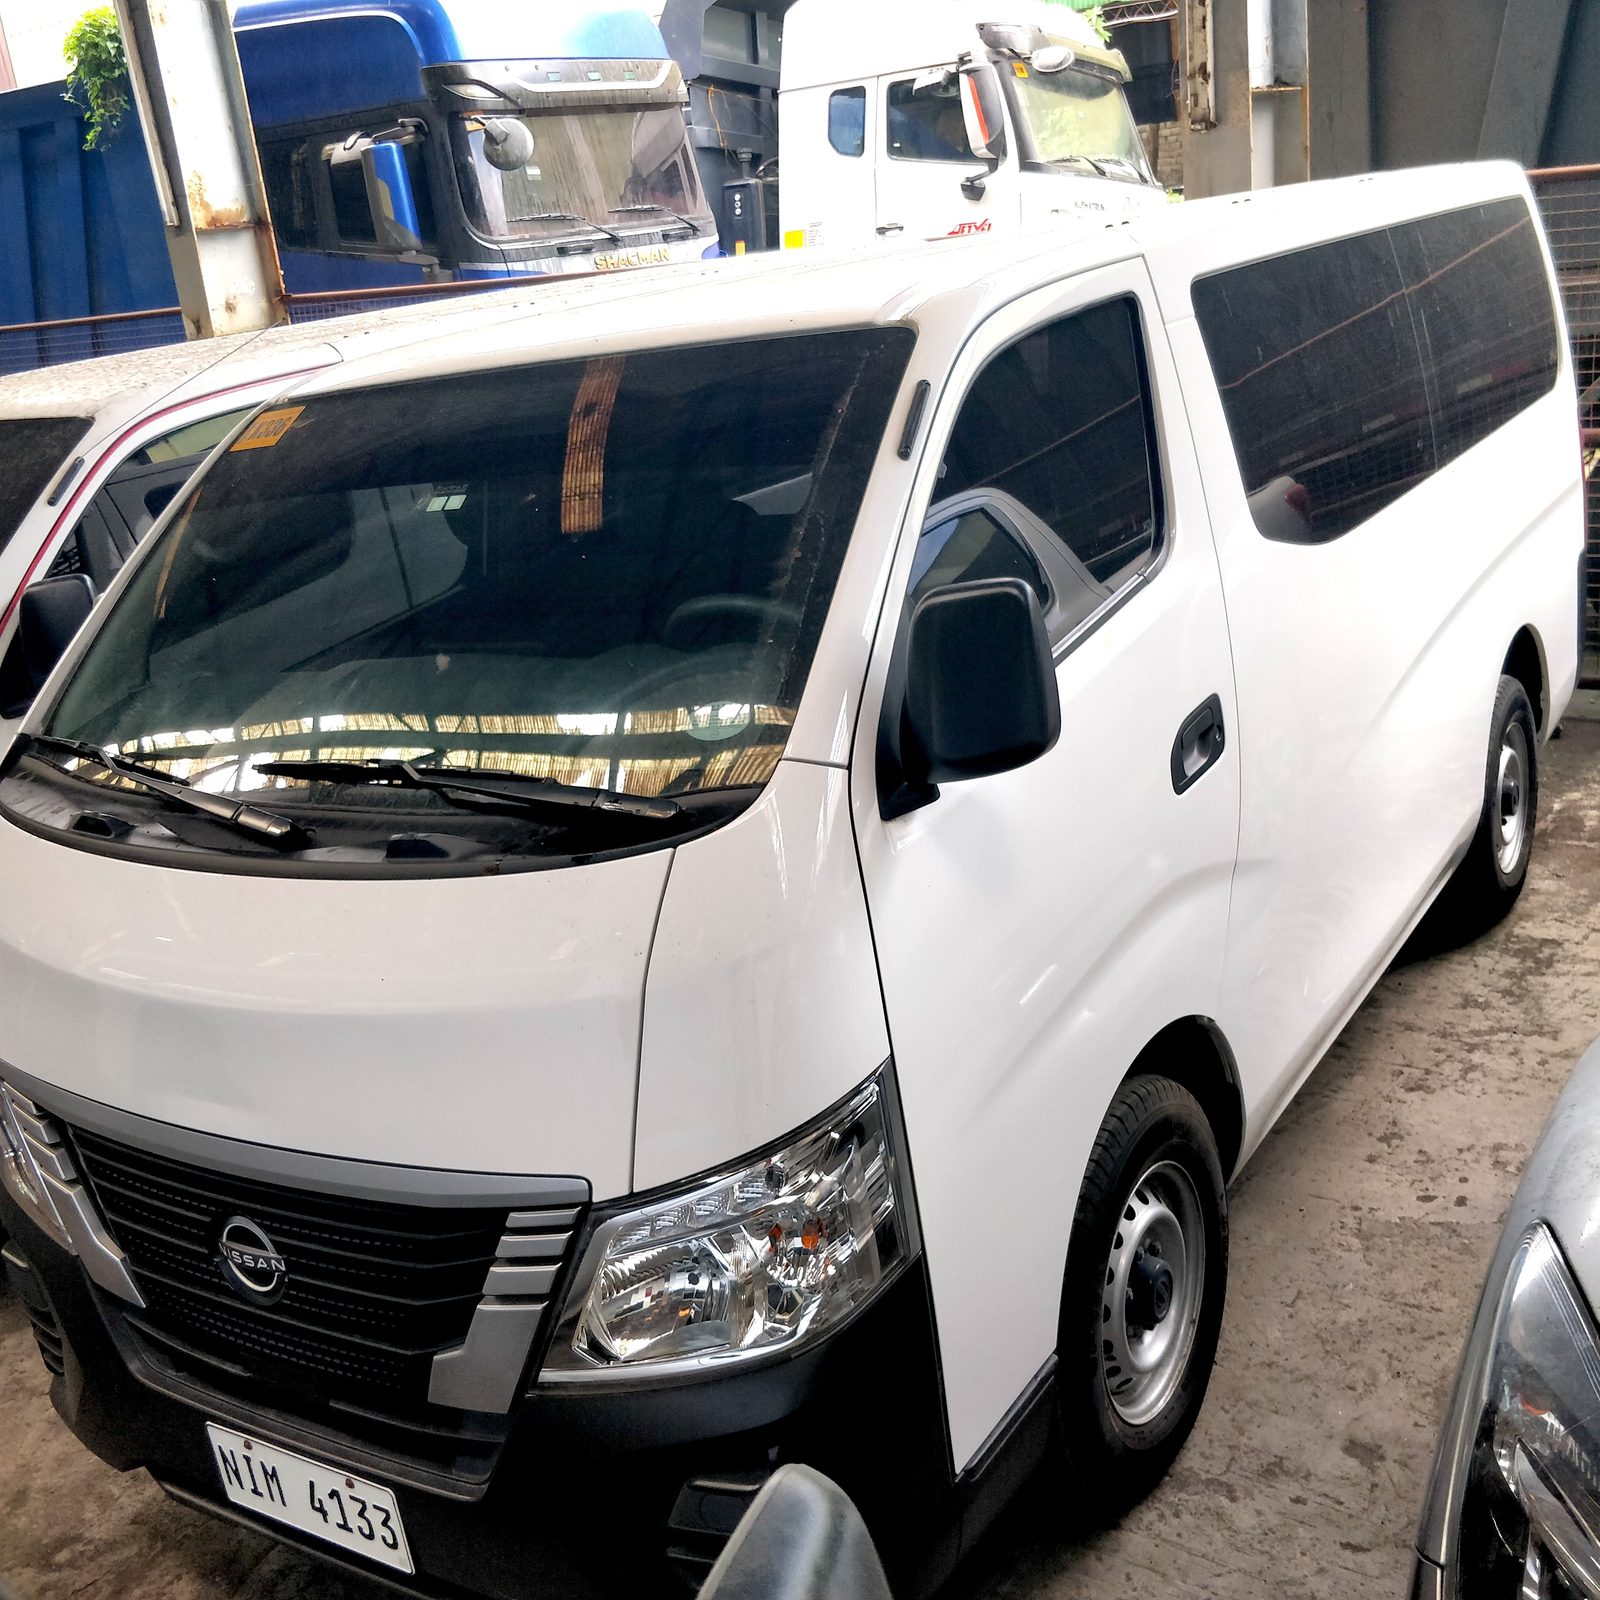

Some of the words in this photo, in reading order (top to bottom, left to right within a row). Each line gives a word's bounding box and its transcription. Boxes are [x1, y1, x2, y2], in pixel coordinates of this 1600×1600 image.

[594, 242, 669, 269] SHACMAN
[218, 1242, 286, 1271] NISSAN
[218, 1445, 287, 1507] NIM
[309, 1479, 399, 1550] 4133
